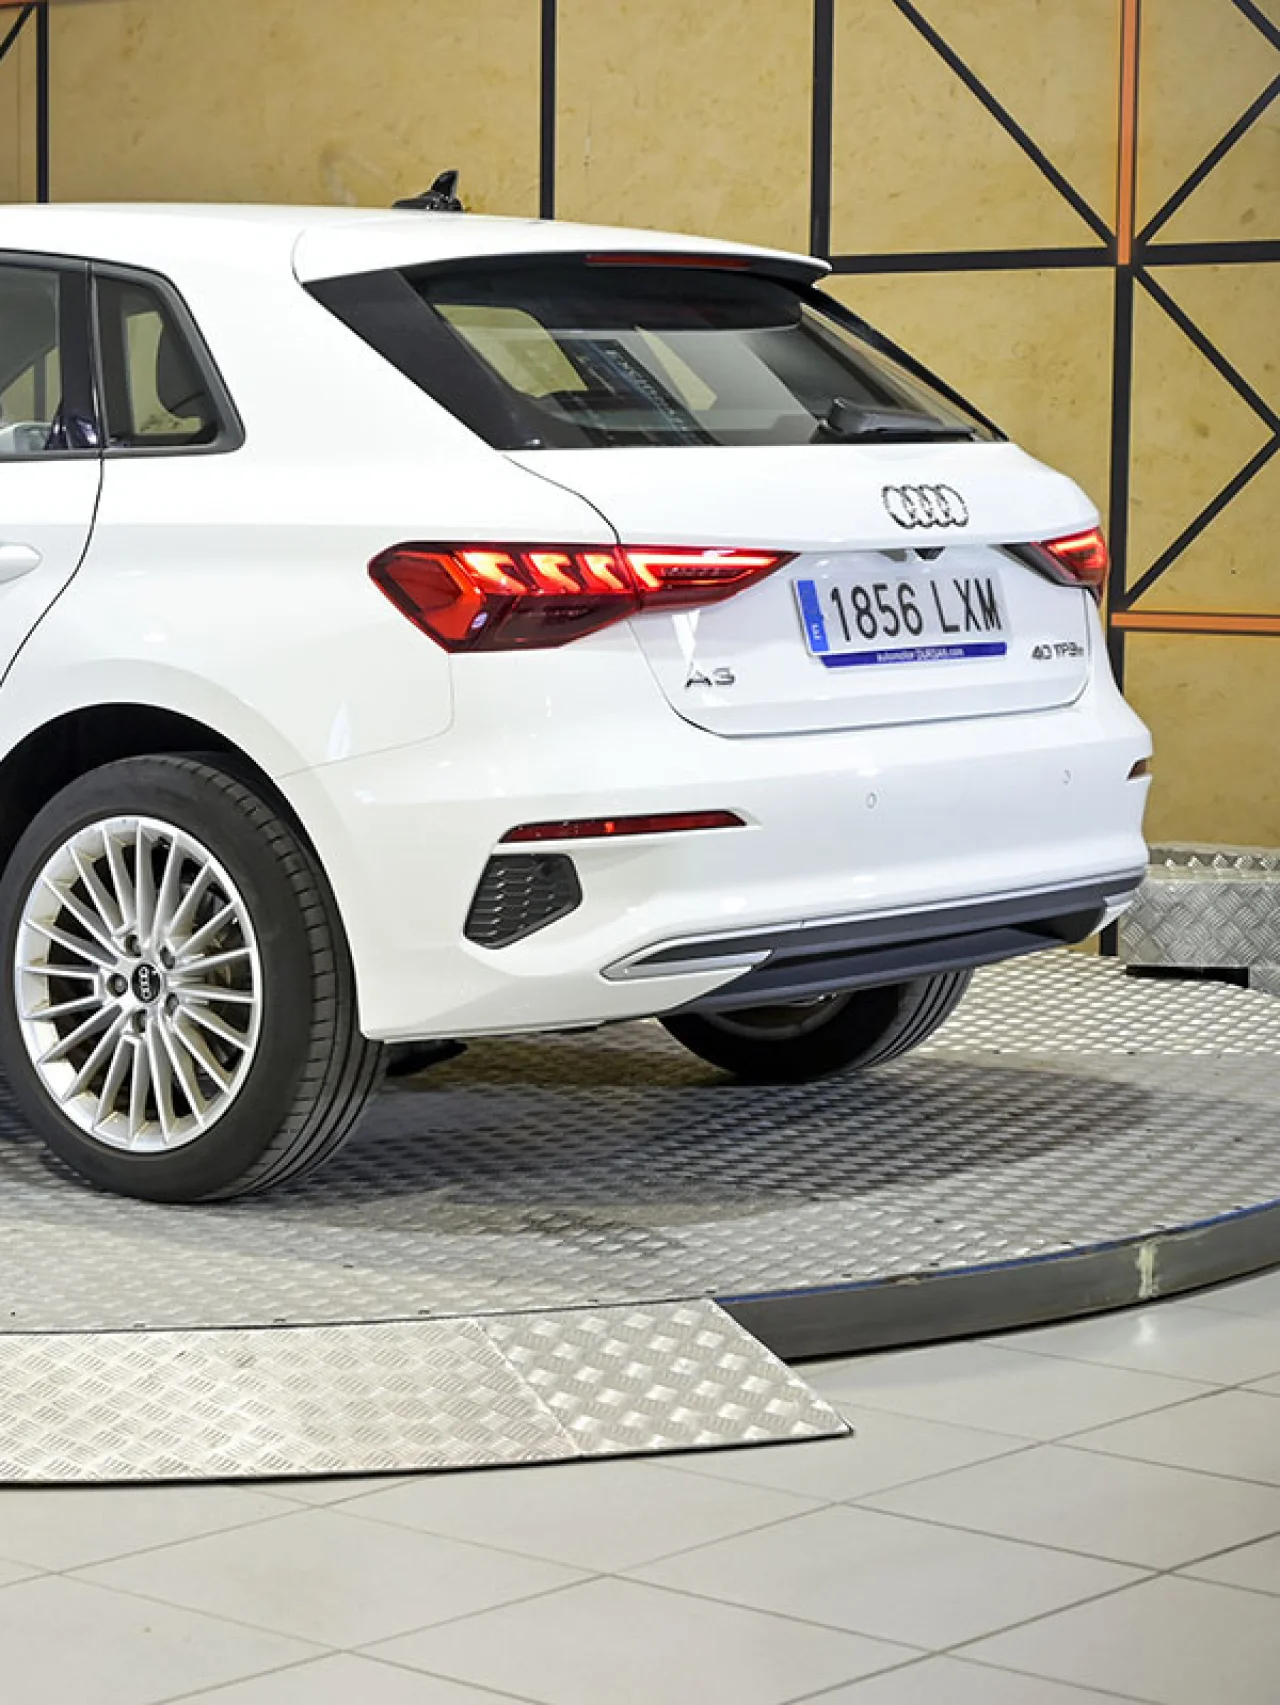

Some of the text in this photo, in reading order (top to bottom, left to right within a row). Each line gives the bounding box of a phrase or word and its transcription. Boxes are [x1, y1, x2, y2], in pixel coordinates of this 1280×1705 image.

[830, 577, 1003, 642] 1856 LXM
[1032, 644, 1052, 660] 40
[684, 667, 735, 688] A3
